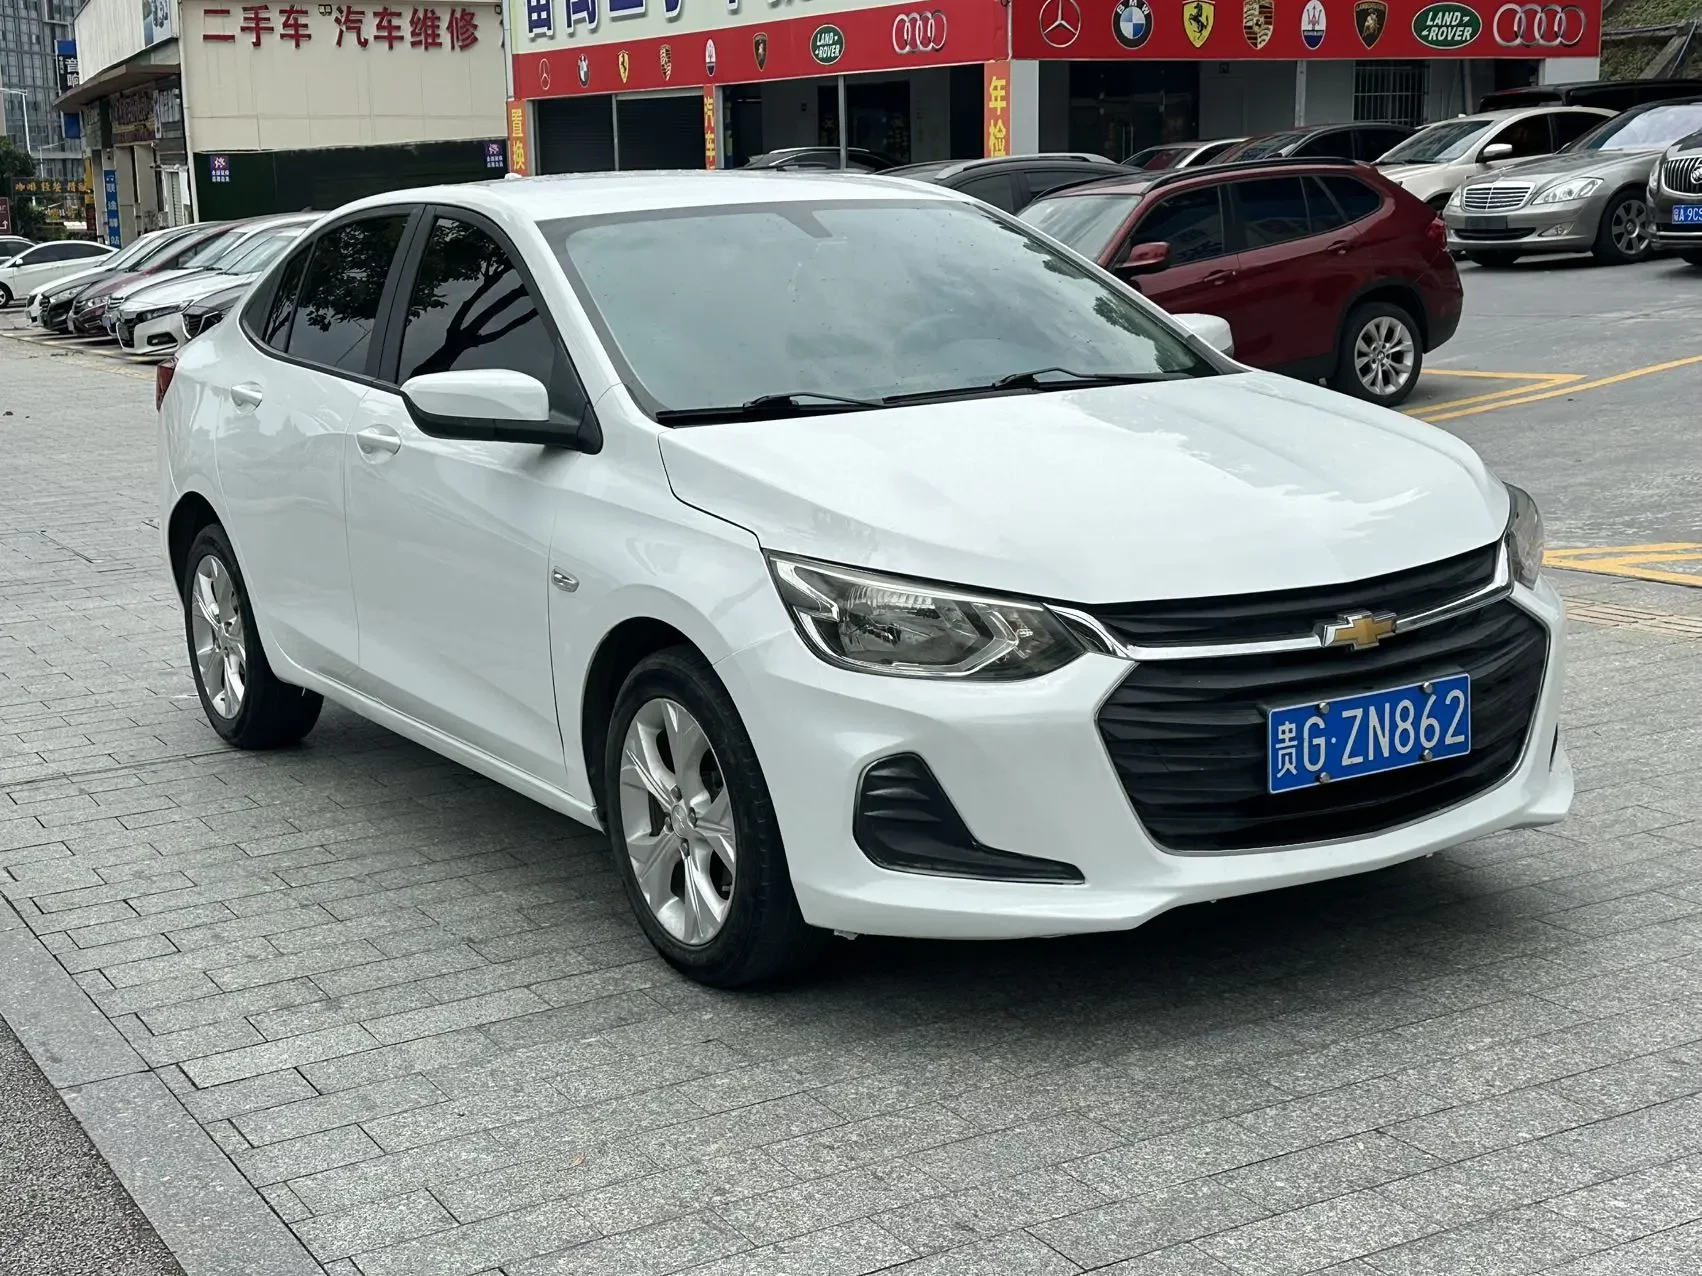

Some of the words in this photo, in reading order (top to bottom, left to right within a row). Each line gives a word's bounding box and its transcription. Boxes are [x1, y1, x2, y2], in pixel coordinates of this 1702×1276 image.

[202, 4, 312, 49] 二手车
[333, 5, 479, 51] 汽车维修
[1426, 11, 1461, 26] LAND
[1428, 26, 1472, 41] ROVER
[816, 32, 834, 46] LAND
[818, 44, 840, 58] ROVER
[704, 96, 716, 169] 汽车
[989, 76, 1007, 158] 年检
[511, 108, 526, 171] 置换
